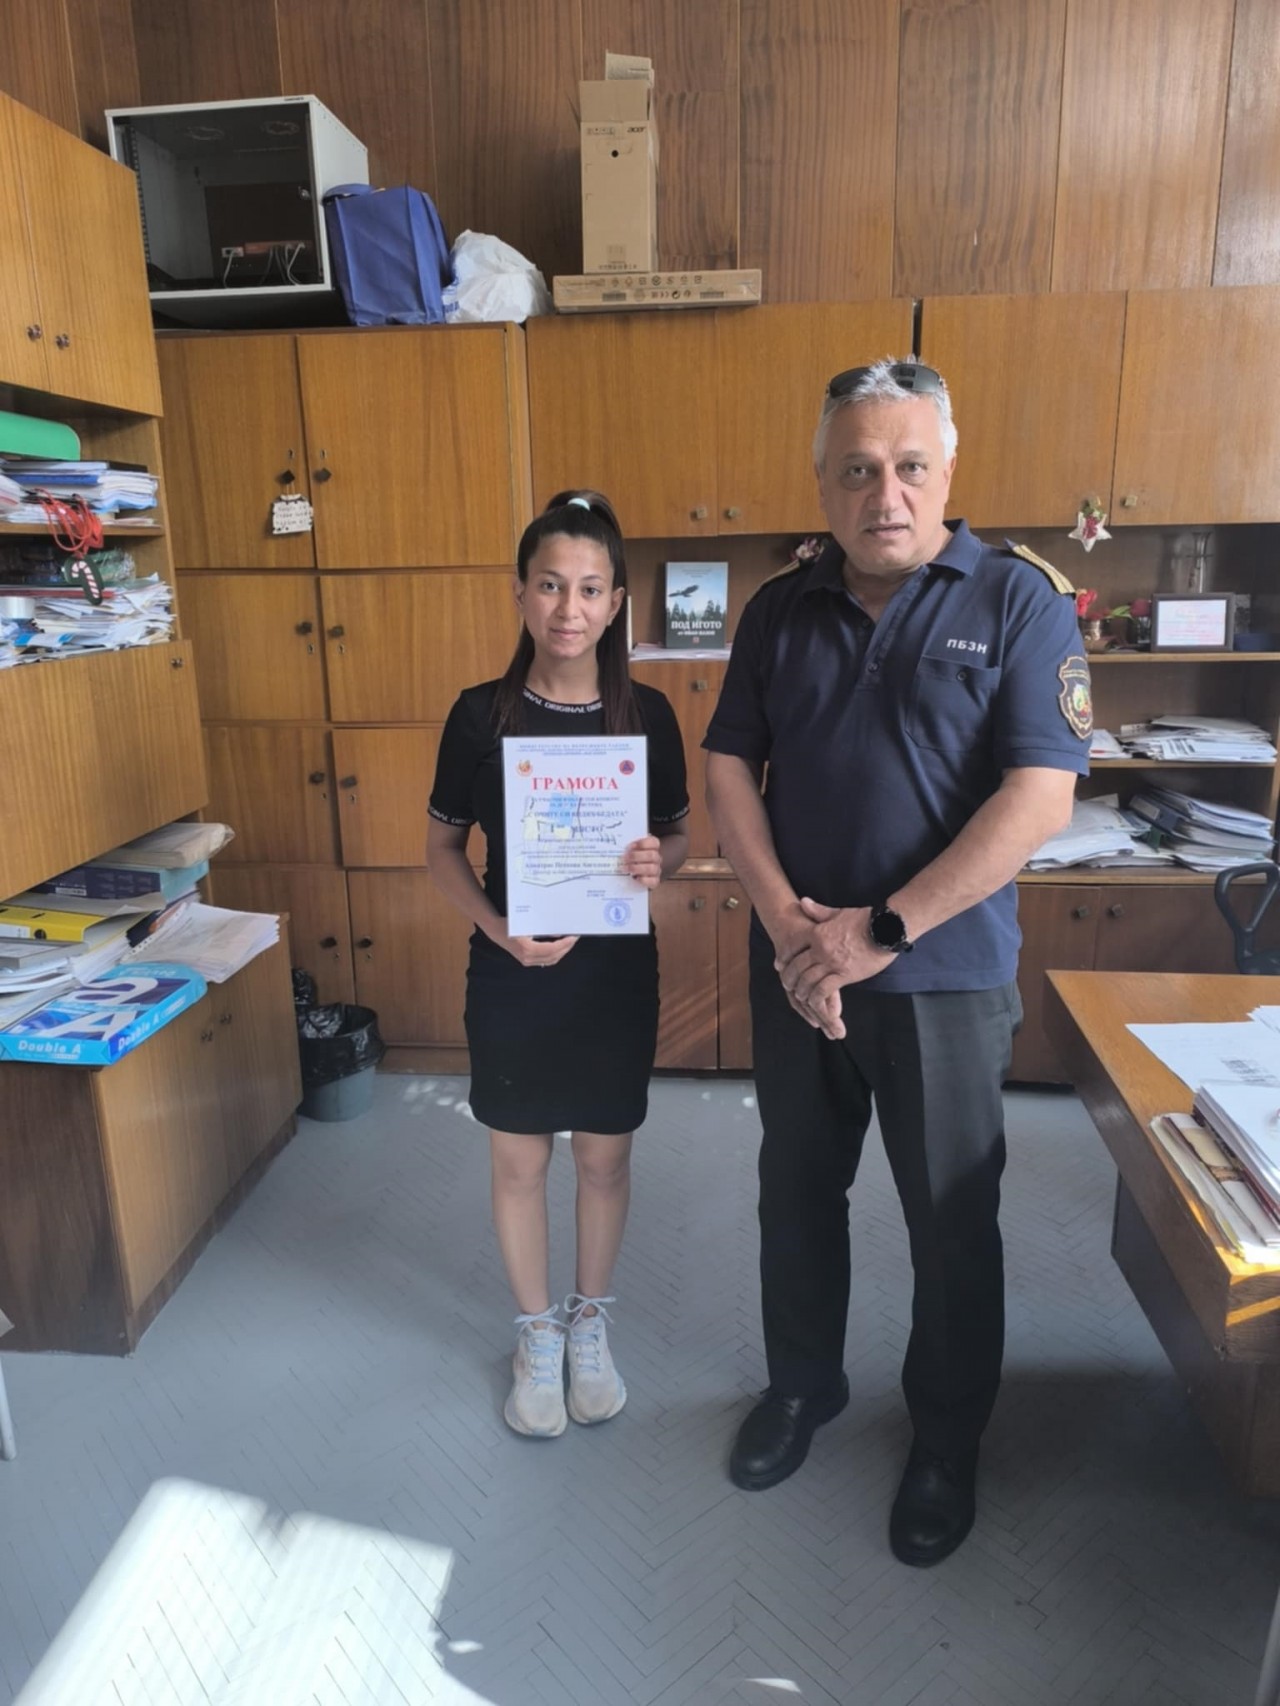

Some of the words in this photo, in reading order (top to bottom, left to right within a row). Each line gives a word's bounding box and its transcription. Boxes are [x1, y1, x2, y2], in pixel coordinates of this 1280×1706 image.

[671, 620, 690, 630] ПОД
[692, 620, 722, 630] ИГОТО
[946, 638, 988, 654] ПБЗН
[532, 776, 618, 790] ГРАМОТА
[117, 1021, 151, 1052] Double
[152, 1013, 160, 1026] A
[17, 1039, 67, 1053] Double
[71, 1043, 81, 1054] A
